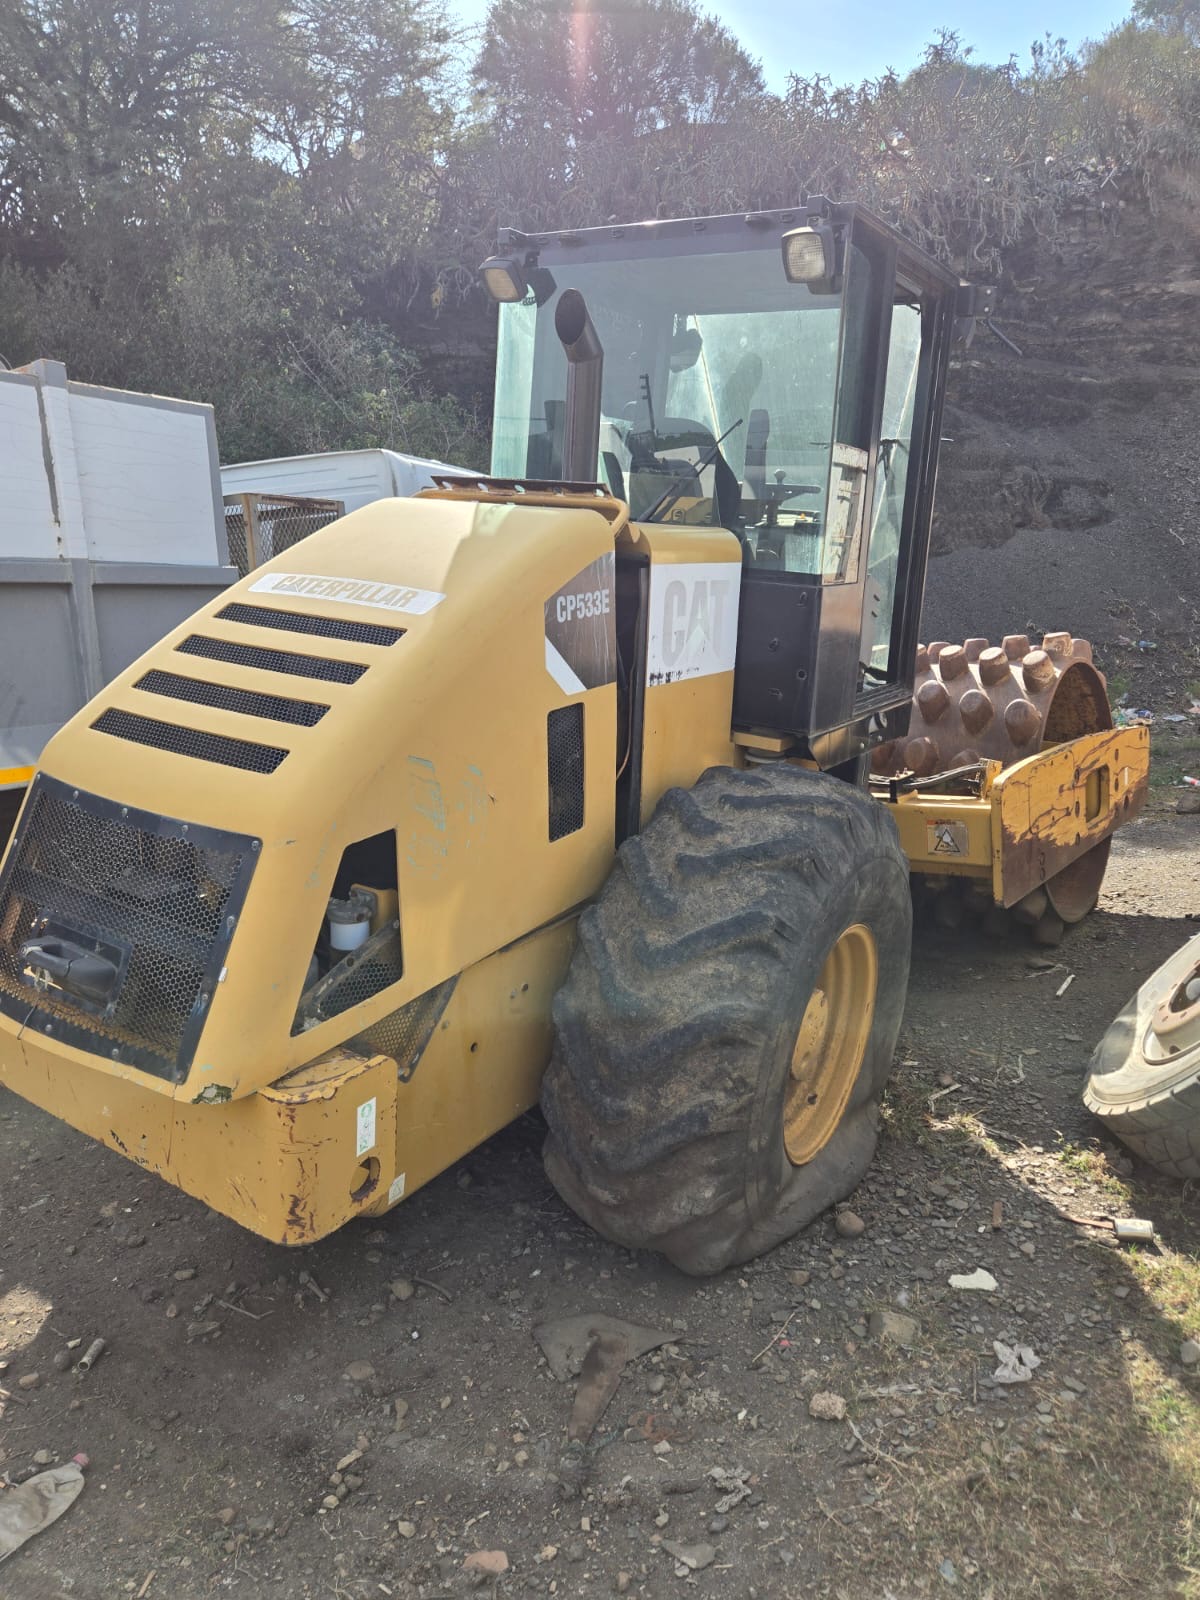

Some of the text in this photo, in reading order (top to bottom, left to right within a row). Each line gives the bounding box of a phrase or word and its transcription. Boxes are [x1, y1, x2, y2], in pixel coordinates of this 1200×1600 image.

[271, 575, 418, 608] CATERPILLAR
[556, 589, 610, 623] CP533E
[662, 579, 731, 667] CAT
